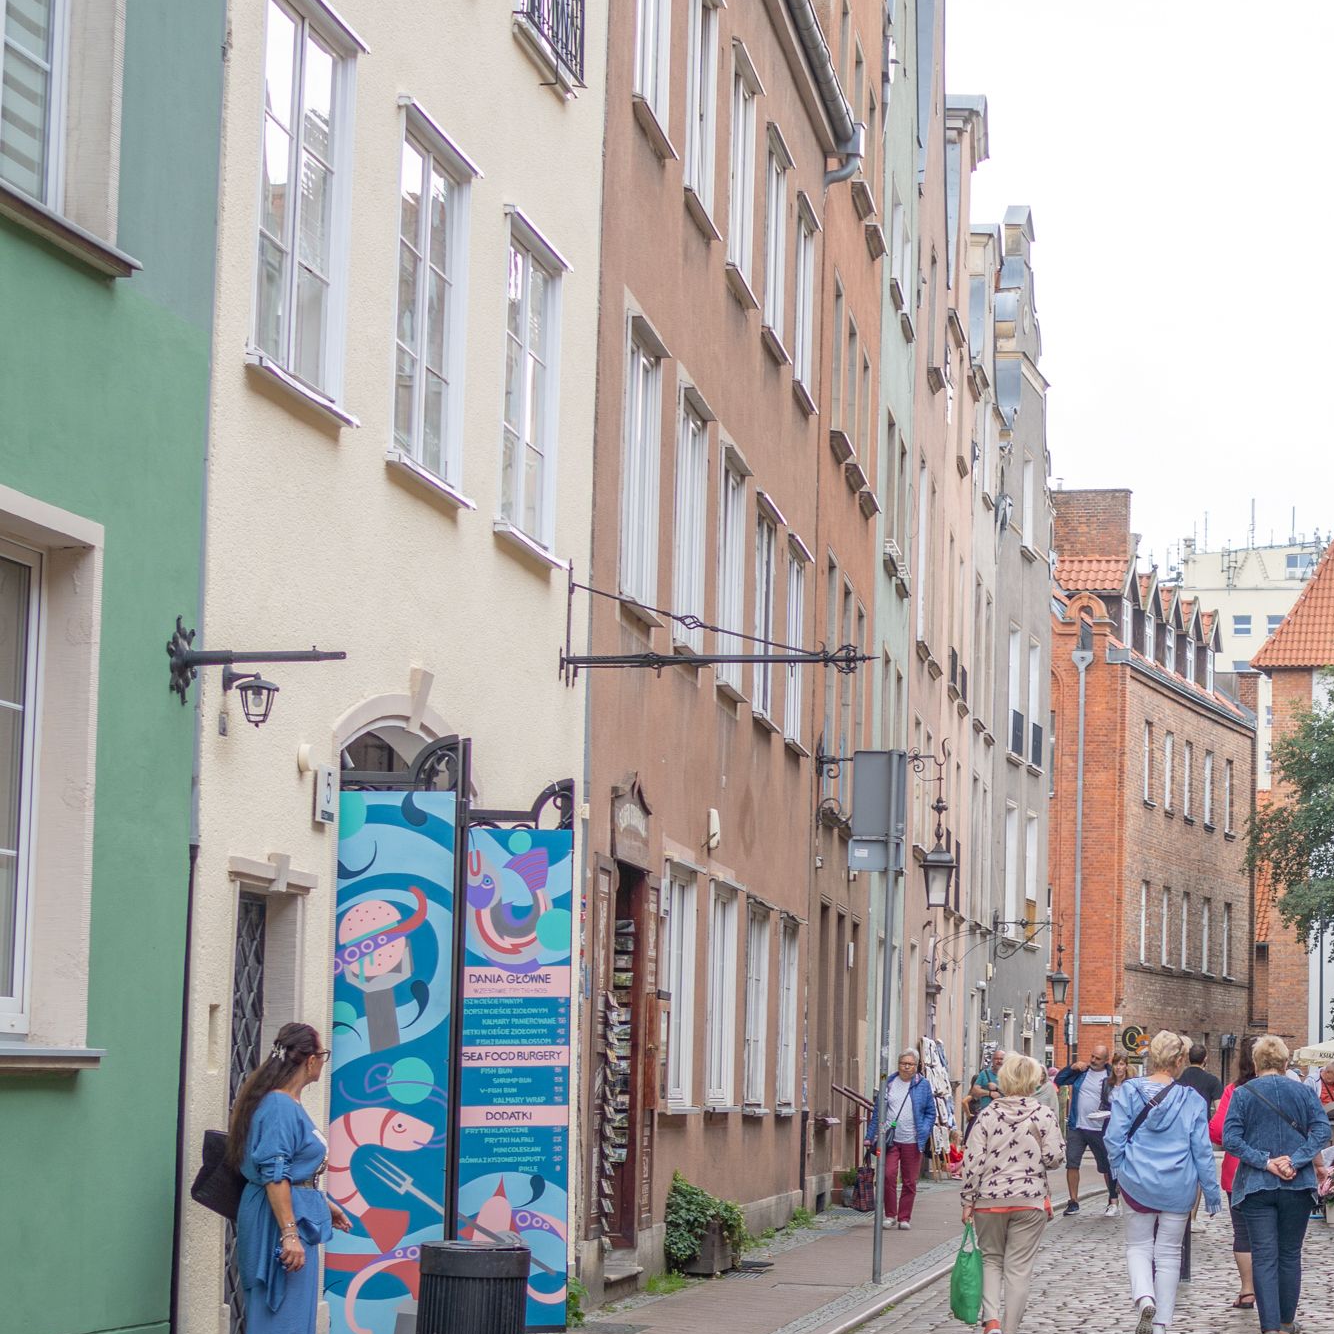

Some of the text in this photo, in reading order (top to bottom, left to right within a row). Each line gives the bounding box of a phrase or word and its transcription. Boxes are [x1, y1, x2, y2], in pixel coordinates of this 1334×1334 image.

[325, 771, 332, 805] 5
[469, 973, 551, 984] DANIA GŁÓWNE
[463, 1051, 562, 1061] SEA FOOD BURGERY
[485, 1111, 532, 1121] DODATKI
